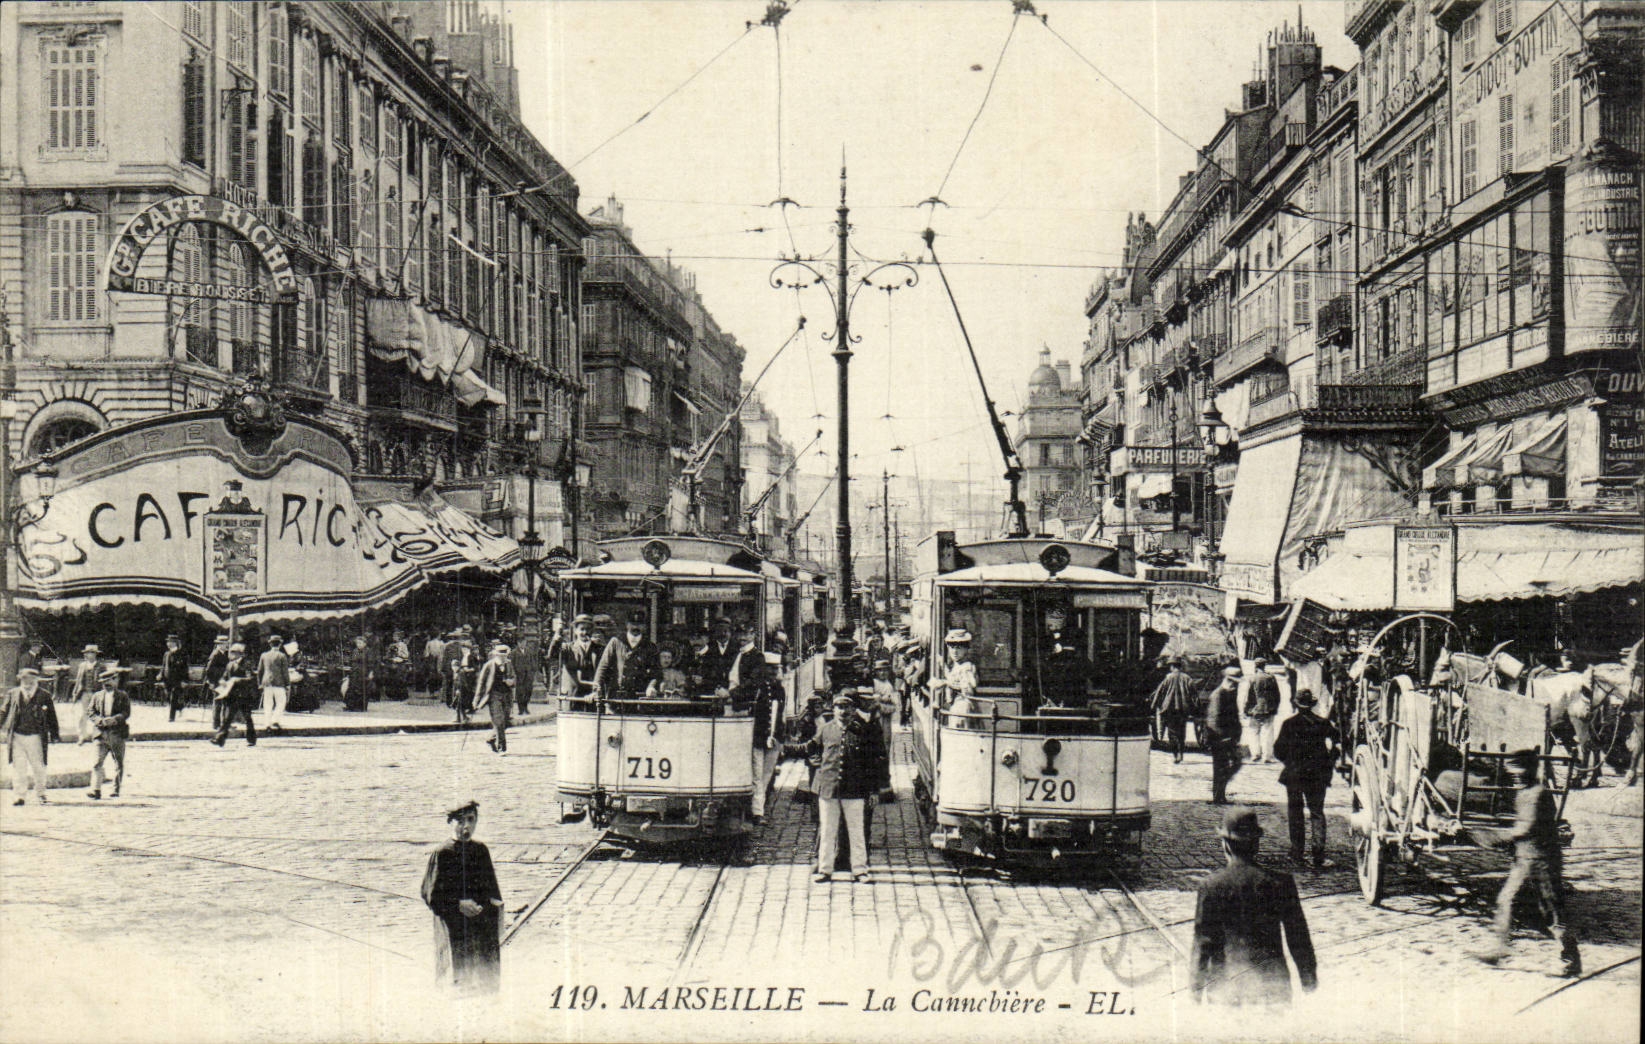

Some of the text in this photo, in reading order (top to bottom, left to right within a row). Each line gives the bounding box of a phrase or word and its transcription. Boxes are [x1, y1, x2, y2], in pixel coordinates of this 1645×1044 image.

[218, 198, 298, 293] RICHE
[87, 491, 210, 549] CAF
[627, 756, 673, 780] 719
[1022, 777, 1076, 803] 720
